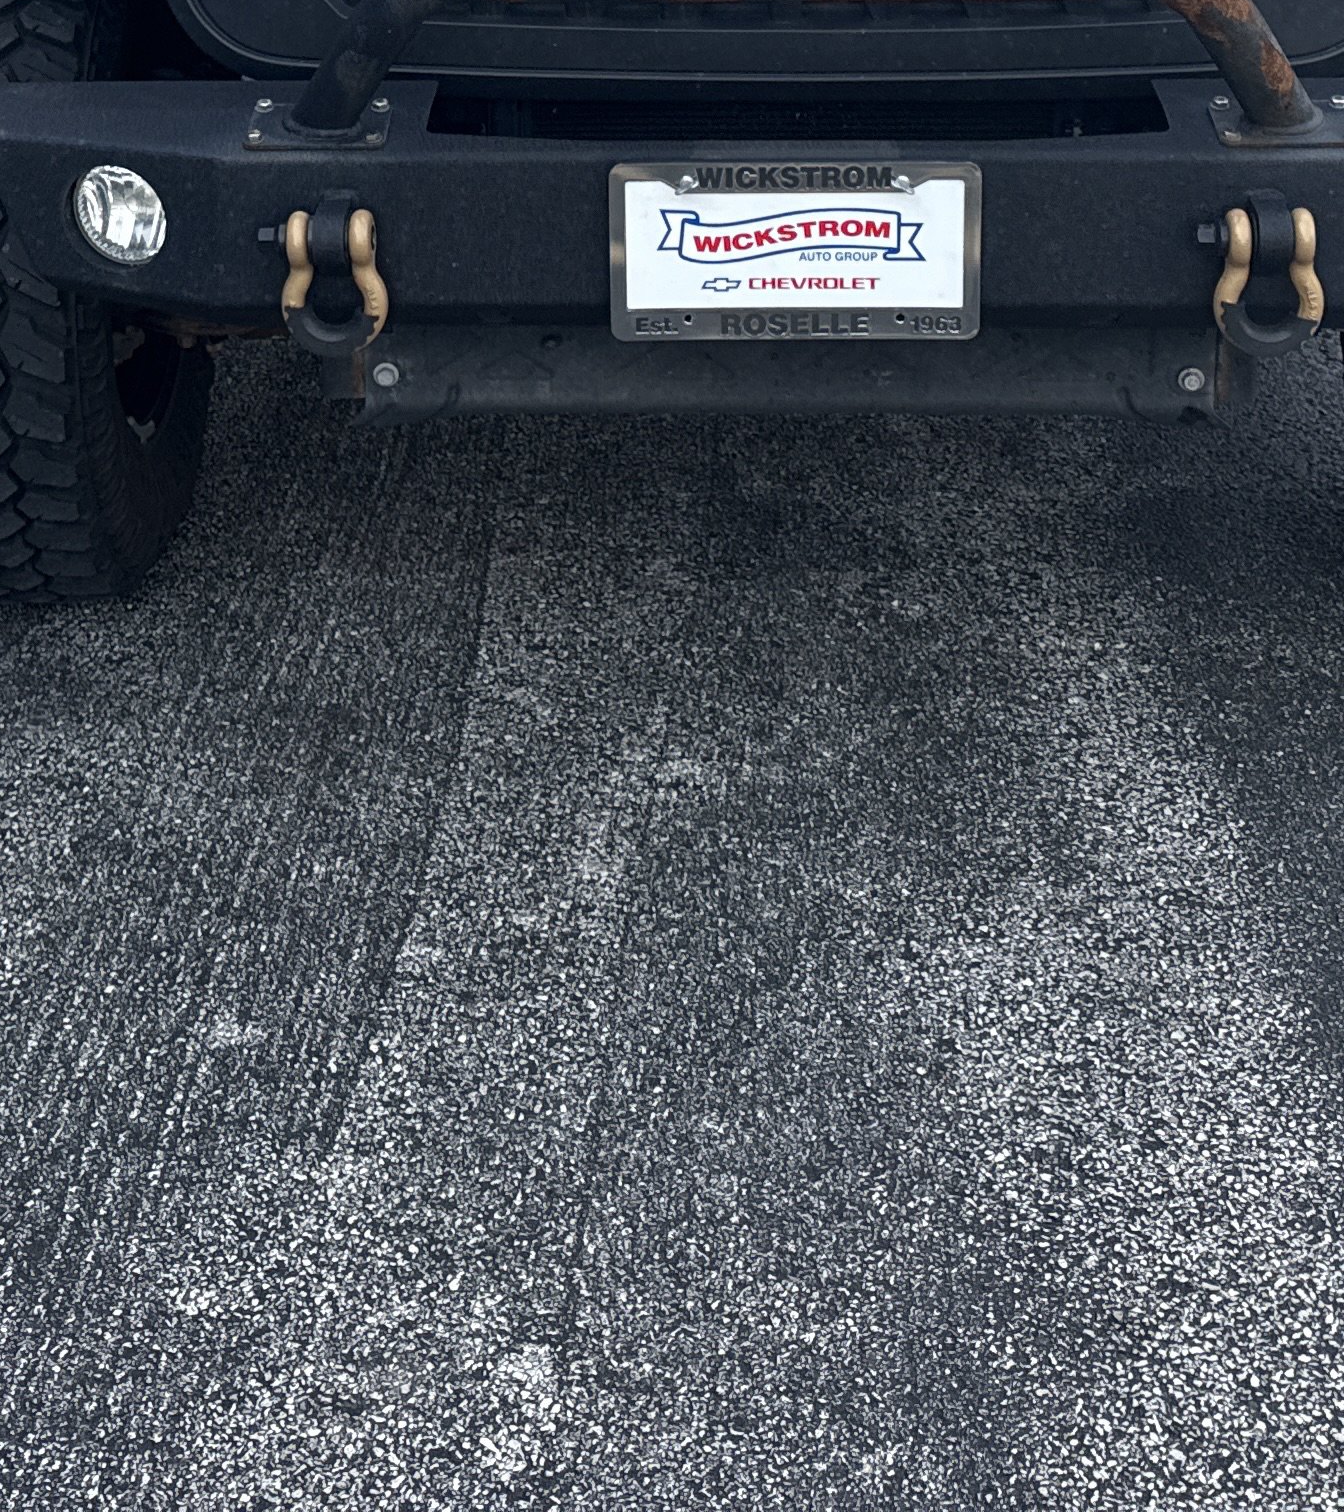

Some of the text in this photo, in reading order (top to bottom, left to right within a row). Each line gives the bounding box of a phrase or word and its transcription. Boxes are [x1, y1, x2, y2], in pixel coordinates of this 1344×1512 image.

[694, 165, 893, 189] WICKSTROM
[693, 220, 891, 253] WICKSTROM
[798, 251, 878, 262] AUTO GROUP
[748, 277, 880, 290] CHEVROLET
[635, 313, 962, 336] Est. ROSELLE 1963
